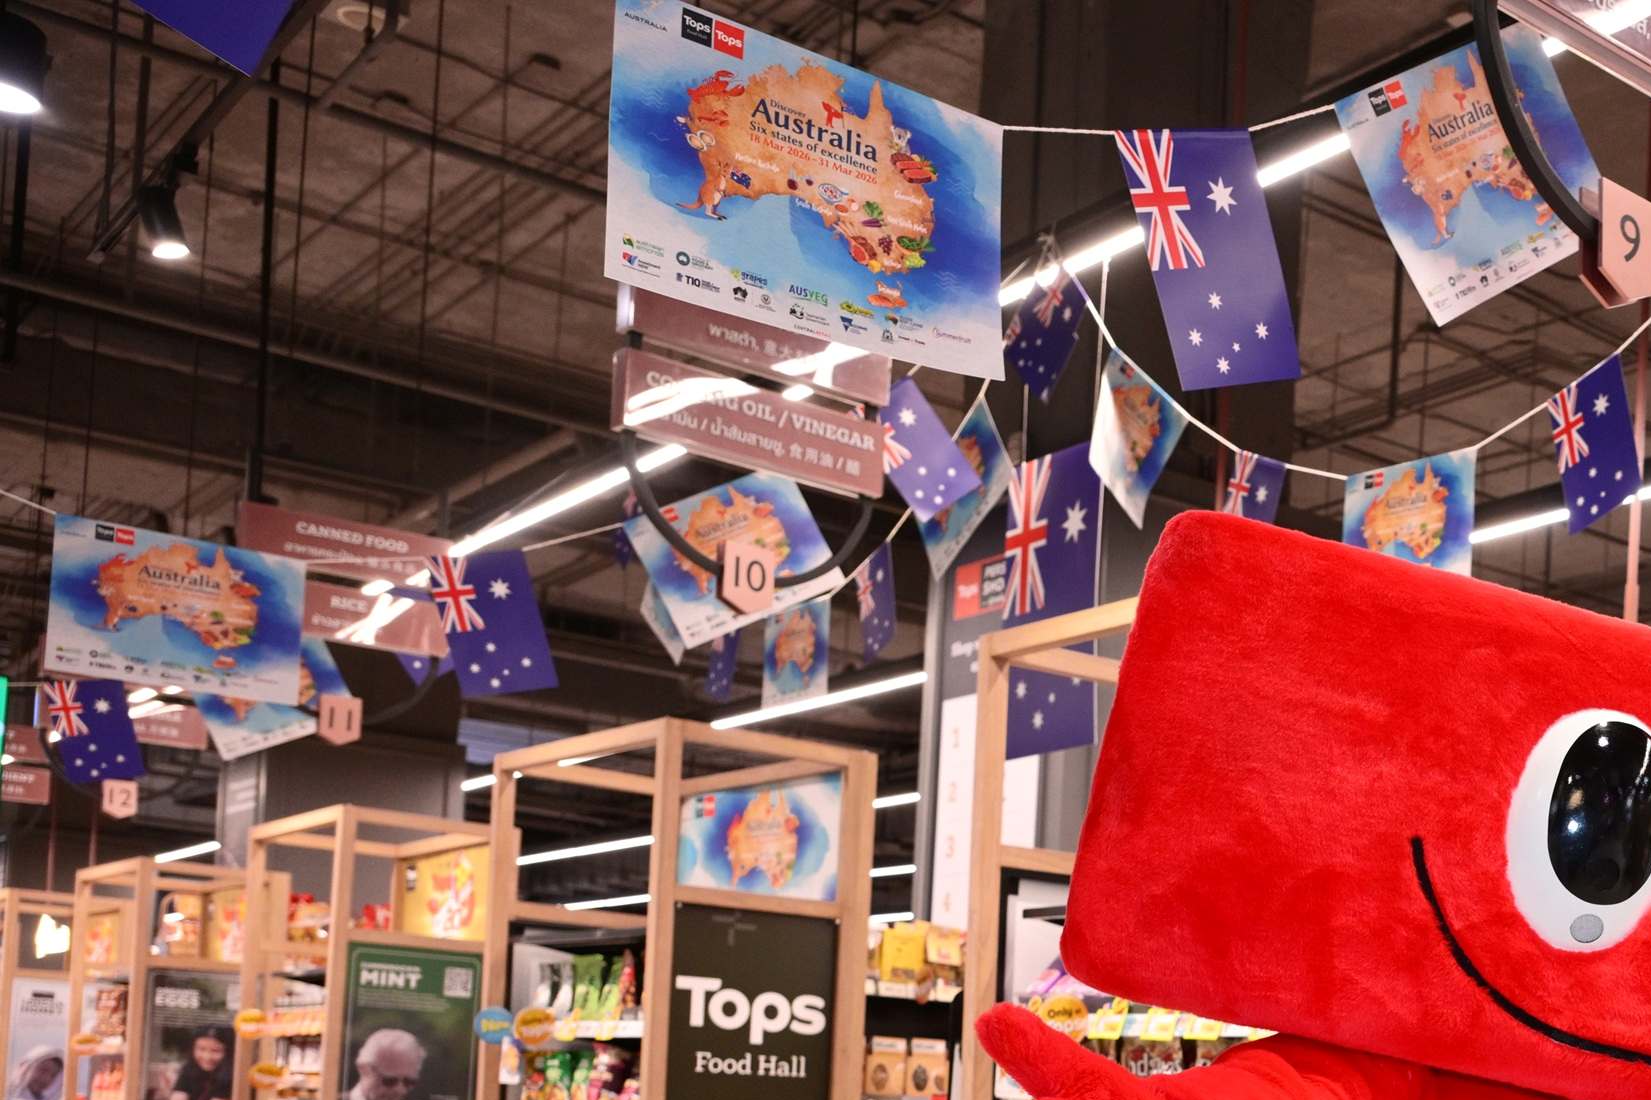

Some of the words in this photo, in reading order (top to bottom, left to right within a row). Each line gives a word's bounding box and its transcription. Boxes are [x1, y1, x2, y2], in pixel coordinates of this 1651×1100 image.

[624, 12, 668, 33] AUSTRALIA
[683, 15, 711, 35] Tops
[715, 29, 743, 49] Tops
[770, 100, 806, 118] Discover
[1427, 100, 1494, 143] Australia
[752, 98, 877, 162] Australia
[750, 121, 767, 135] Six
[772, 131, 803, 148] states
[806, 143, 819, 153] of
[821, 148, 878, 174] excellence
[750, 134, 760, 144] 18
[763, 139, 784, 151] Mar
[787, 147, 811, 161] 2026
[832, 161, 853, 175] Mar
[855, 171, 877, 185] 2026
[1619, 213, 1642, 263] 9
[743, 401, 776, 422] OIL
[778, 411, 787, 428] /
[791, 413, 876, 451] VINEGAR
[294, 520, 360, 549] CANNED
[363, 532, 409, 554] FOOD
[136, 563, 222, 592] Australia
[734, 555, 766, 592] 10
[327, 708, 354, 732] 11
[107, 788, 133, 810] 12
[359, 969, 423, 990] MINT
[675, 974, 827, 1046] Tops
[695, 1051, 752, 1076] Food
[757, 1053, 807, 1078] Hall
